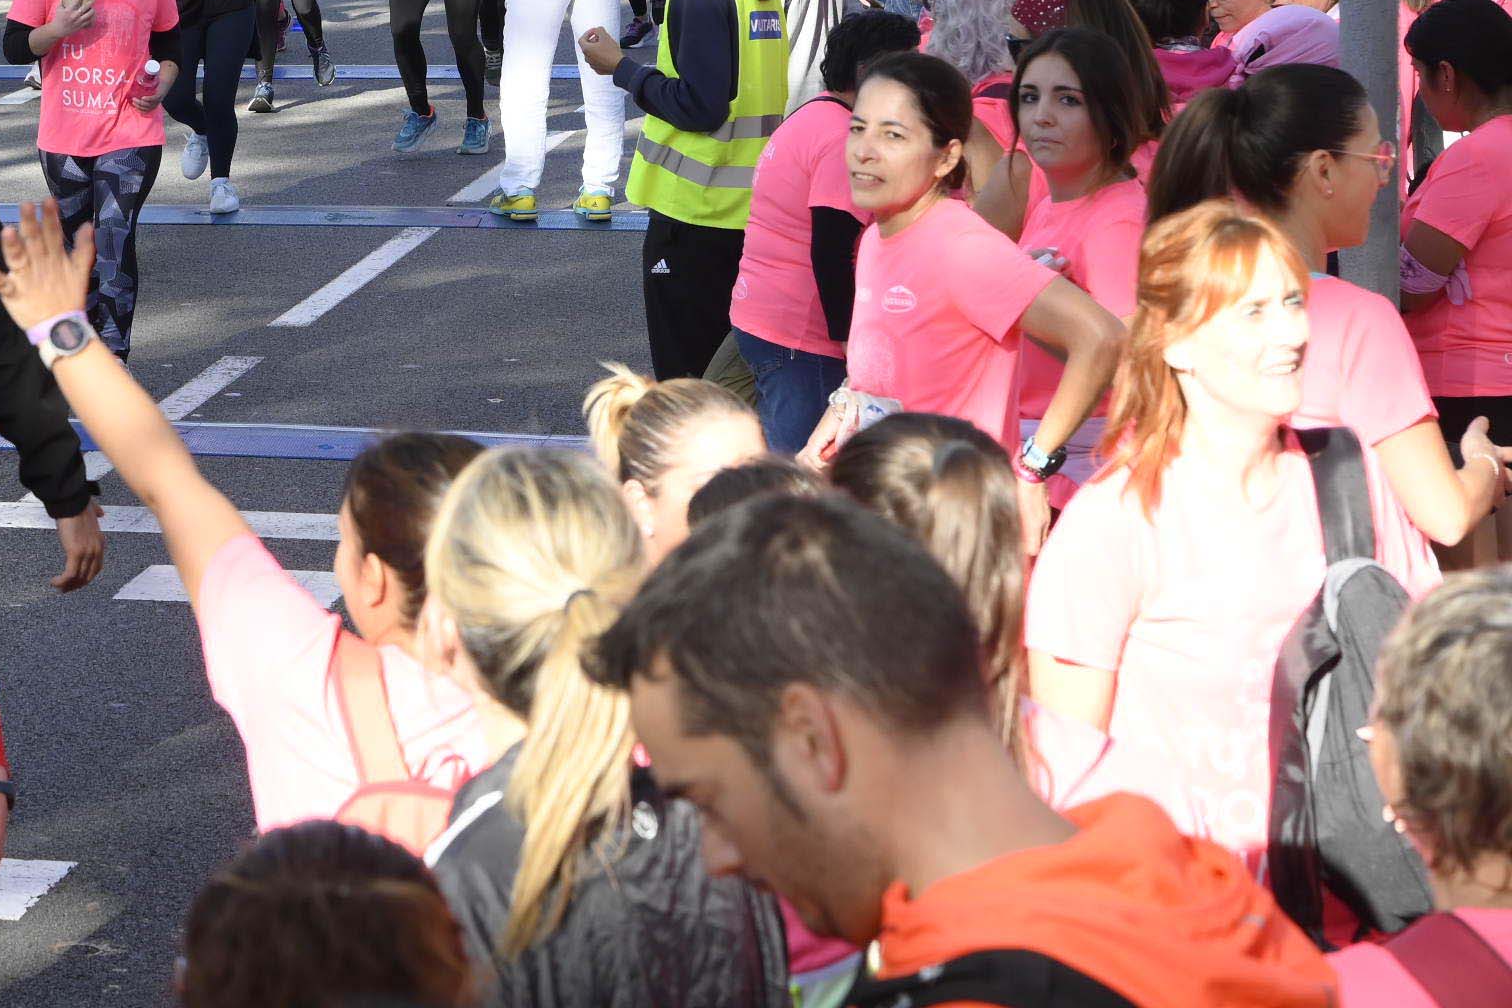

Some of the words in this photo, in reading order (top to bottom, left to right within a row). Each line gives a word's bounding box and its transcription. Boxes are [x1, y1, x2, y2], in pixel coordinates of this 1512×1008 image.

[62, 42, 84, 60] TU
[62, 67, 131, 83] DORSA
[62, 90, 117, 108] SUMA
